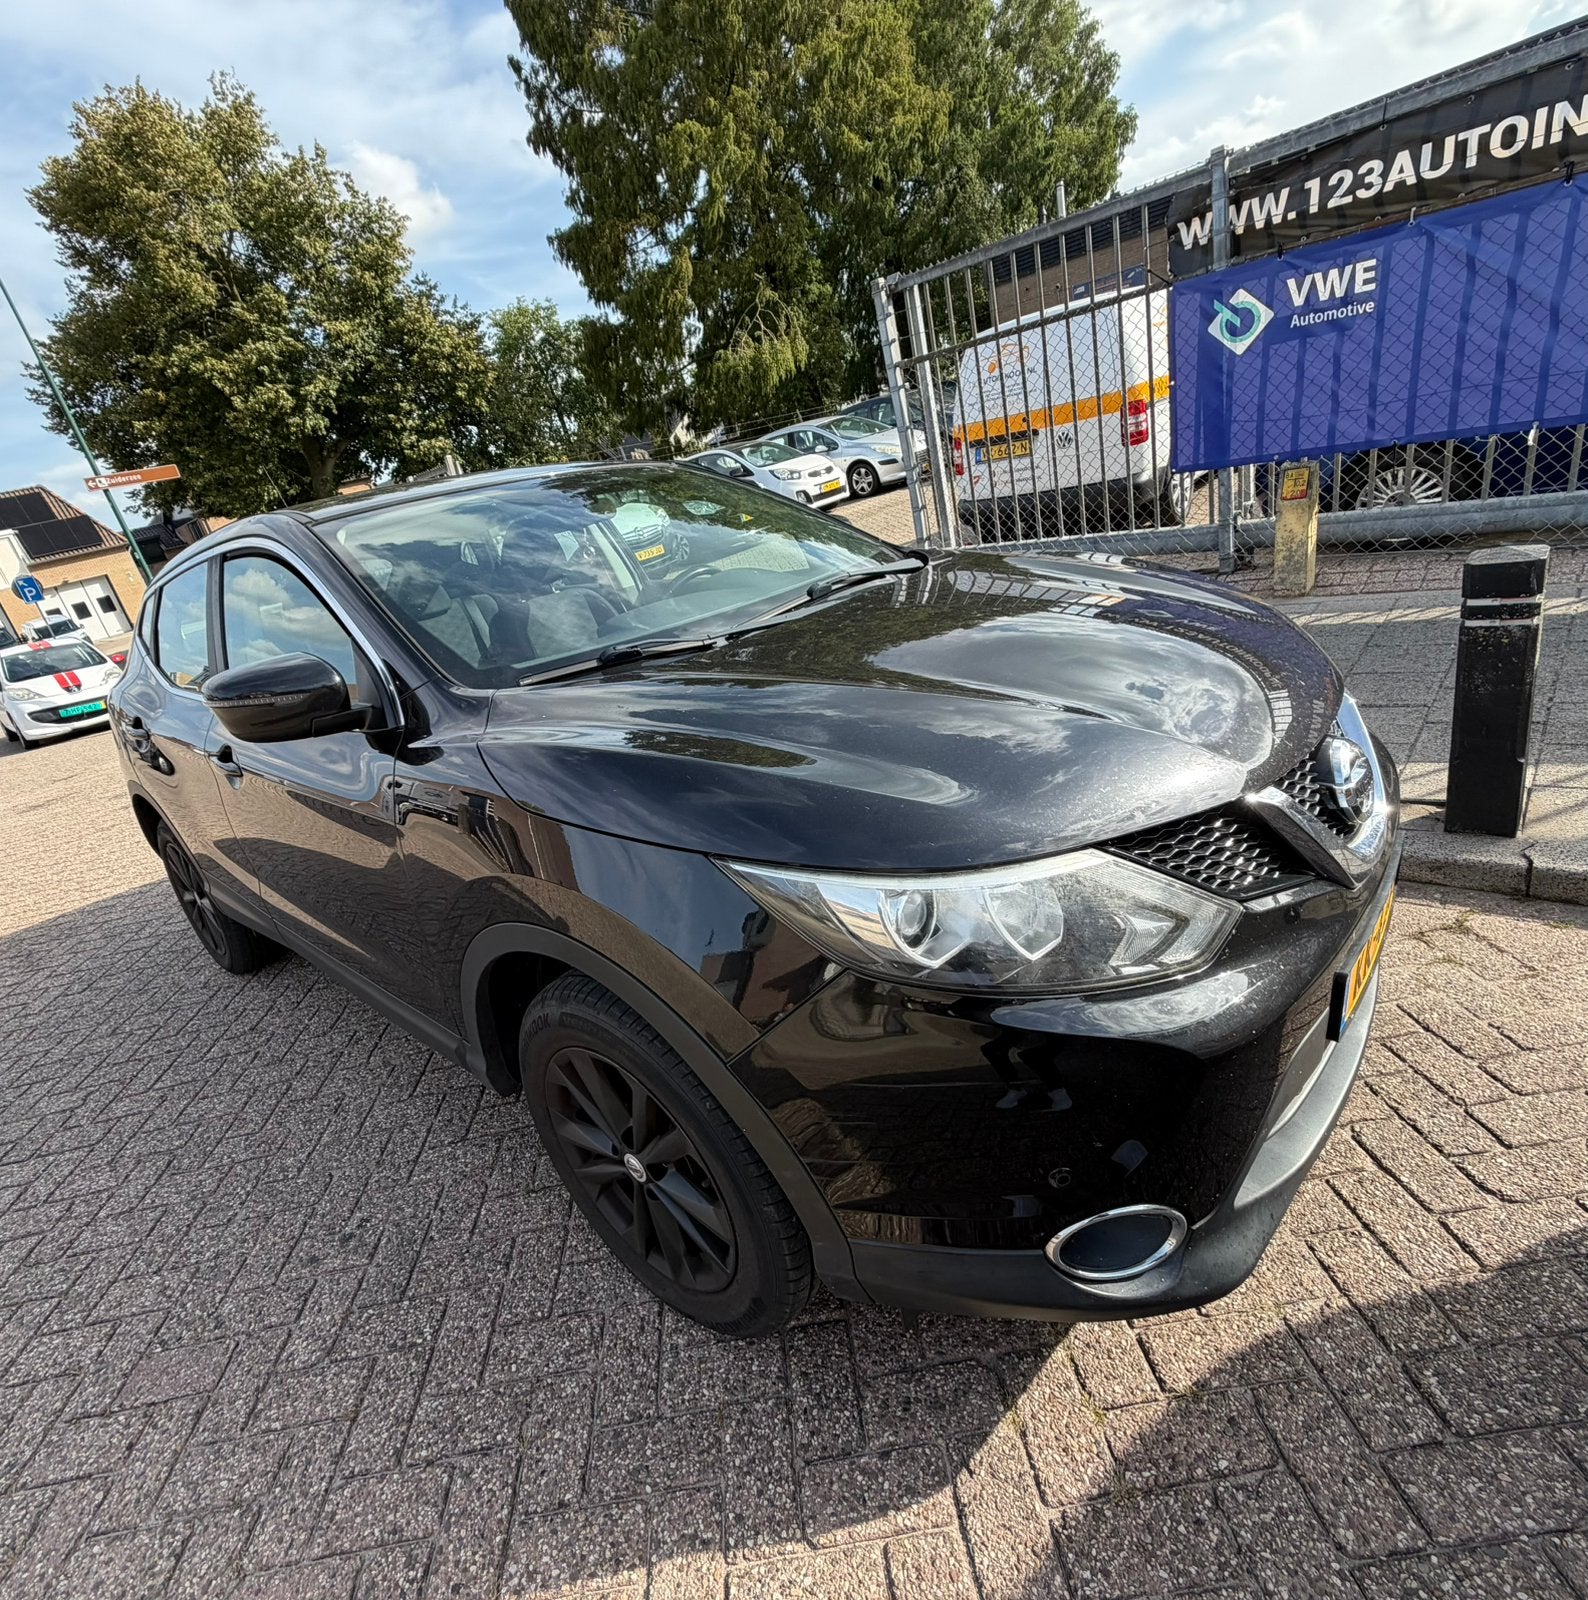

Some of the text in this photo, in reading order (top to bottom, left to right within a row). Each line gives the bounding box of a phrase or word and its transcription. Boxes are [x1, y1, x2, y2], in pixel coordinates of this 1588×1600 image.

[1287, 258, 1378, 307] VWE
[1290, 300, 1376, 329] Automotive
[106, 474, 142, 485] Zuiderzee
[23, 587, 36, 601] P
